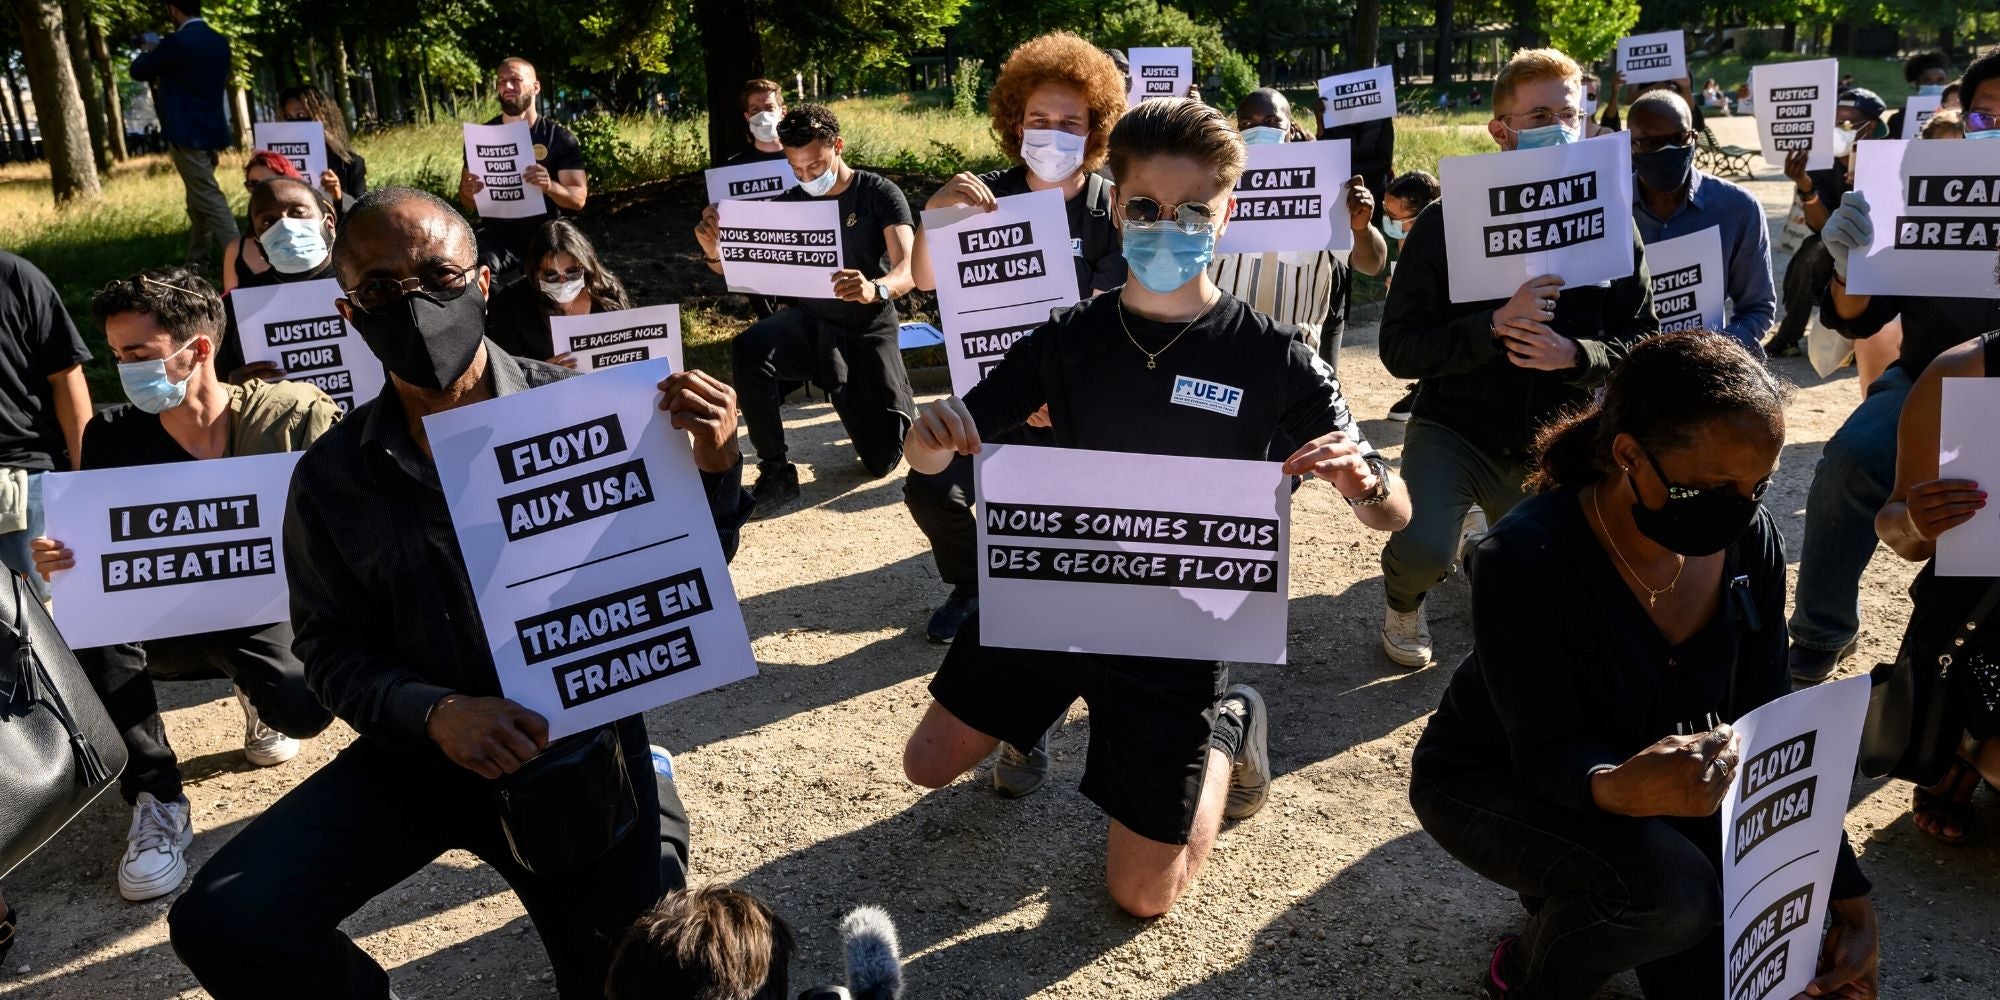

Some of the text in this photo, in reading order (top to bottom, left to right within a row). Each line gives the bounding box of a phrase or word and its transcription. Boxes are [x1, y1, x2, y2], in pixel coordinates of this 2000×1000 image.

[1638, 45, 1665, 55] CAN'T
[1143, 68, 1177, 76] JUSTICE
[1627, 57, 1671, 69] BREATHE
[1148, 82, 1171, 91] POUR
[1345, 81, 1374, 93] CAN'T
[1772, 88, 1816, 100] JUSTICE
[1335, 94, 1380, 109] BREATHE
[1778, 106, 1807, 117] POUR
[1773, 122, 1813, 133] GEORGE
[272, 144, 308, 154] JUSTICE
[479, 146, 516, 157] JUSTICE
[1776, 139, 1809, 150] FLOYD
[487, 162, 512, 171] POUR
[485, 174, 520, 186] GEORGE
[733, 178, 780, 195] I CAN'T
[1251, 170, 1311, 188] CAN'T
[492, 190, 520, 200] FLOYD
[1499, 176, 1592, 212] I CAN'T
[1918, 179, 1928, 203] I
[719, 229, 834, 245] NOUS SOMMES TOUS
[967, 226, 1024, 252] FLOYD
[1489, 212, 1603, 253] BREATHE
[723, 248, 836, 264] DES GEORGE FLOYD
[962, 256, 1042, 284] AUX USA
[270, 319, 342, 344] JUSTICE
[573, 326, 664, 350] LE RACISME NOUS
[963, 329, 1034, 355] TRAOR
[287, 348, 334, 369] POUR
[598, 350, 643, 367] ÉTOUFFE
[1194, 382, 1240, 405] UEJF
[511, 424, 610, 478] FLOYD
[510, 470, 647, 534] AUX USA
[121, 499, 250, 537] I CAN'T
[987, 508, 1274, 546] NOUS SOMMES TOUS
[108, 544, 273, 587] BREATHE
[990, 548, 1273, 584] DES GEORGE FLOYD
[522, 580, 702, 656] TRAORE EN
[563, 637, 692, 701] FRANCE
[1747, 740, 1805, 794] FLOYD
[1736, 787, 1809, 859] AUX USA
[1730, 894, 1807, 988] TRAORE EN
